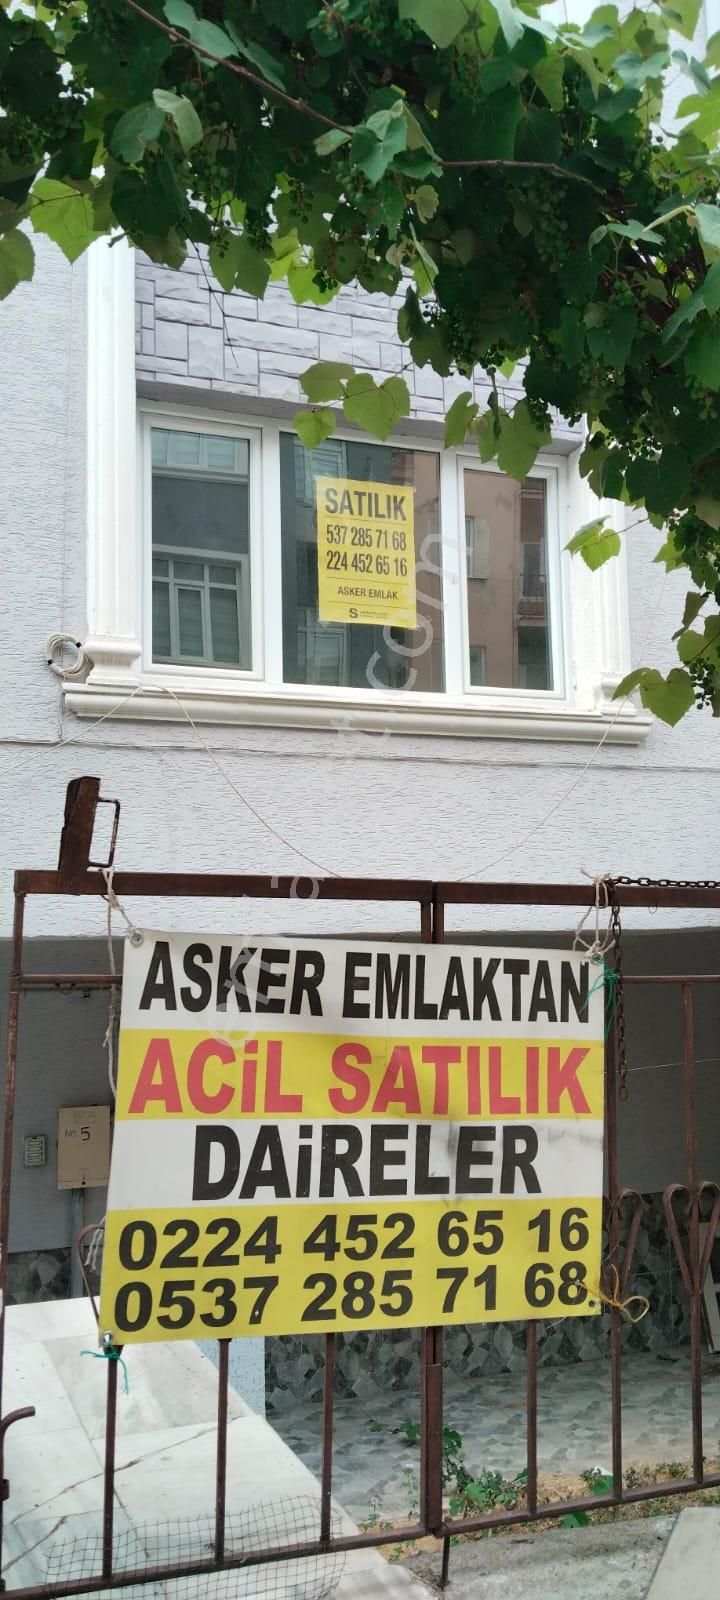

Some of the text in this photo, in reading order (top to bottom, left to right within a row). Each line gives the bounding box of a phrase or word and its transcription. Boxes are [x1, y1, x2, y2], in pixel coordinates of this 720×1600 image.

[325, 487, 406, 521] SATILIK
[326, 524, 406, 551] 537 285 71 68
[326, 550, 407, 577] 224 452 65 16
[338, 586, 398, 600] ASKER EMLAK
[349, 608, 358, 619] S
[139, 940, 589, 1023] ASKER EMLAKTAN
[328, 1042, 592, 1116] SATILIK
[80, 1126, 91, 1141] 5
[119, 1207, 590, 1271] 0224 452 65 16
[114, 1261, 589, 1332] 0537 285 71 68
